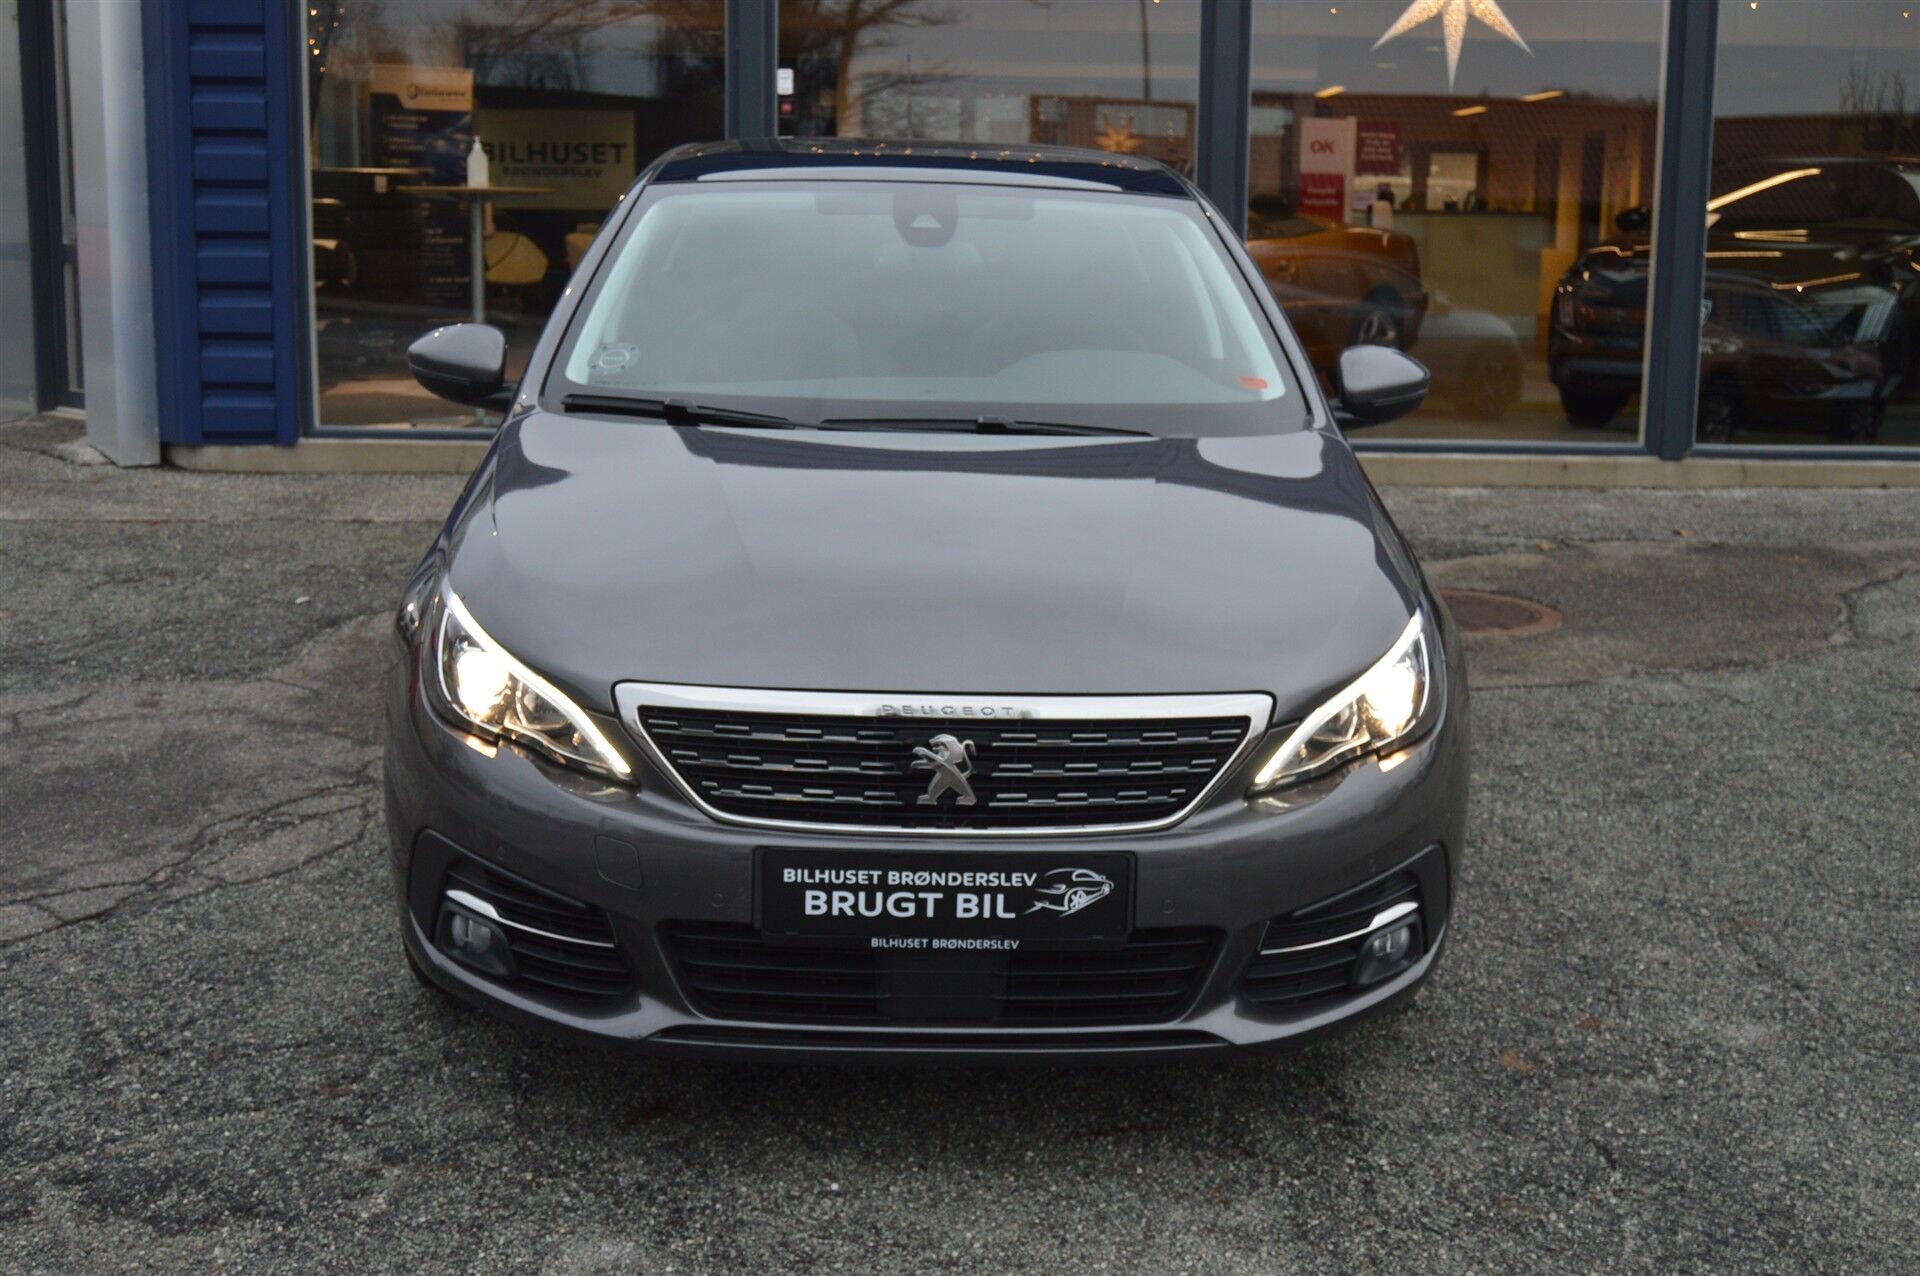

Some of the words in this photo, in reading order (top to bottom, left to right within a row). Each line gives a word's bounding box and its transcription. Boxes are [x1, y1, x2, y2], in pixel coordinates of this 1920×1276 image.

[483, 142, 627, 165] BILHUSET
[1310, 140, 1335, 154] OK
[881, 704, 1014, 717] PEUGEOT
[783, 868, 882, 885] BILHUSET
[887, 871, 1037, 888] BRØNDERSLEV
[804, 890, 944, 919] BRUGT
[956, 893, 1016, 919] BIL
[870, 937, 928, 949] BILHUSET
[932, 938, 1020, 950] BRØNDERSLEV
